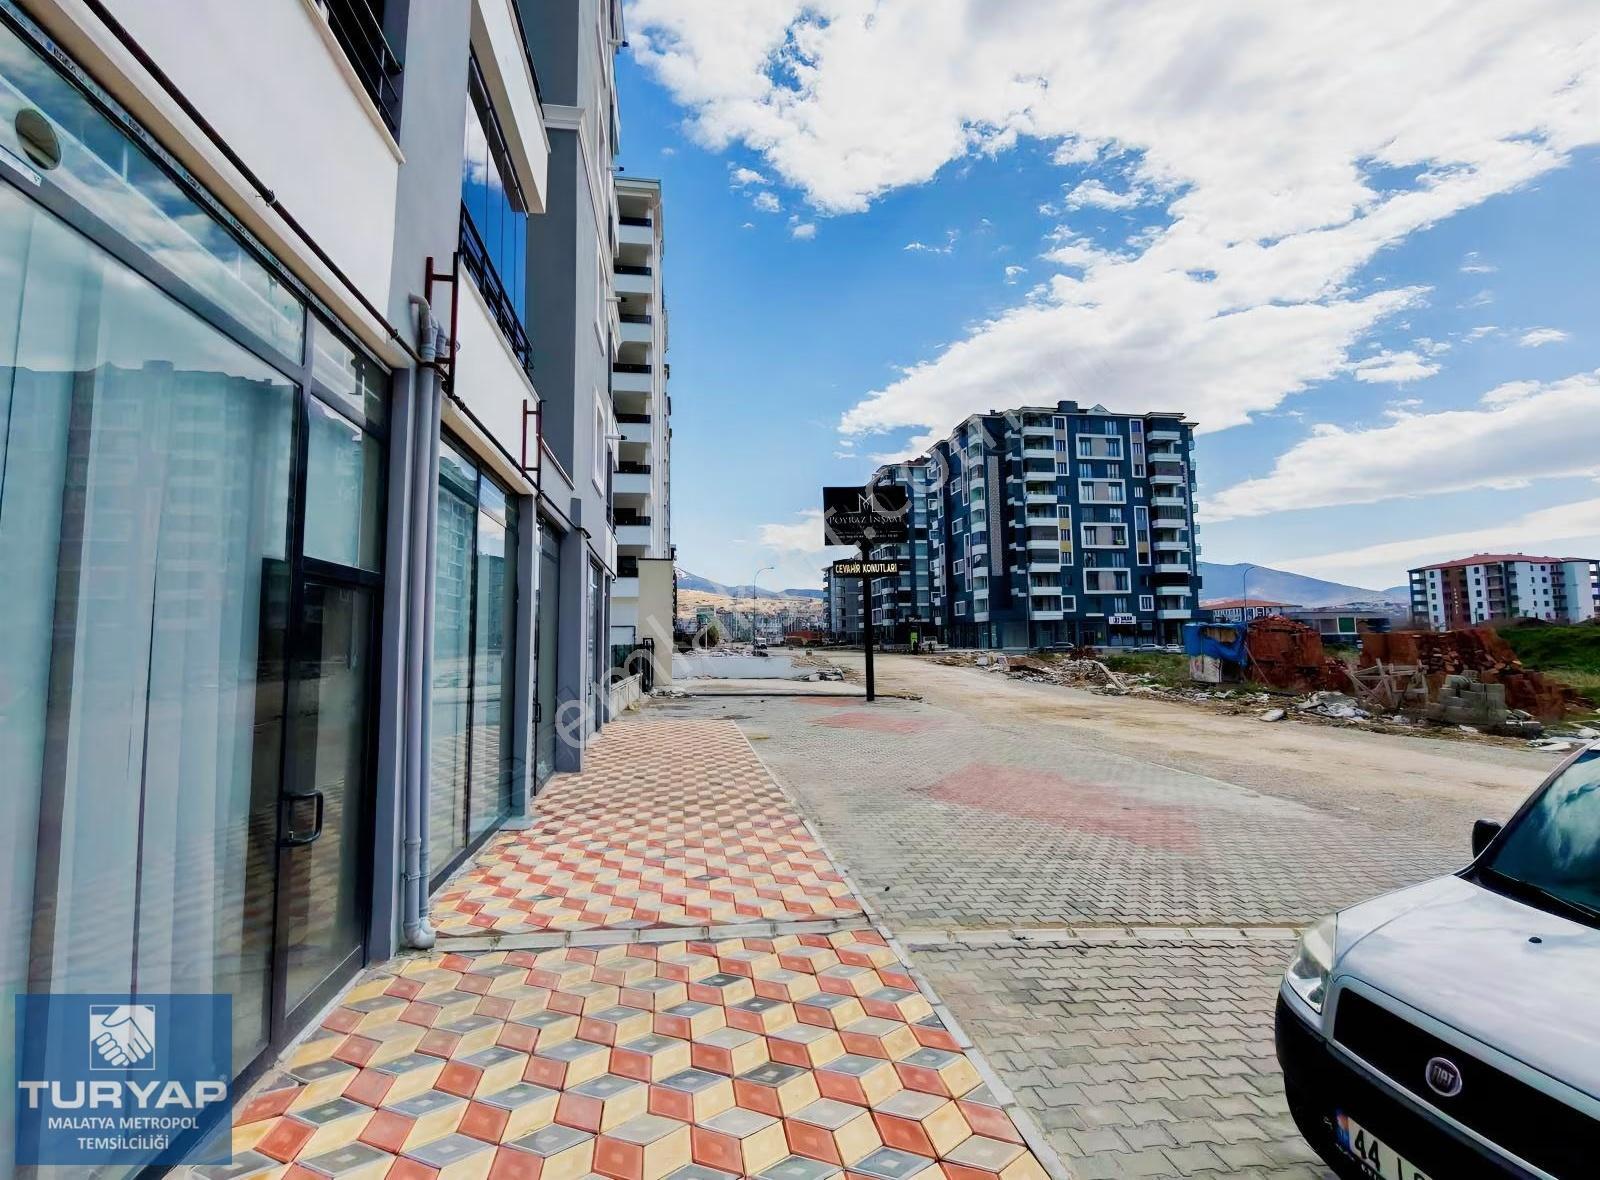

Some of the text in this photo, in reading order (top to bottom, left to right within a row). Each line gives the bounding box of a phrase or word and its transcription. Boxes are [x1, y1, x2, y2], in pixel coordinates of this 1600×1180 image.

[835, 562, 898, 573] CEVAHİR KONUTLARI
[1354, 1129, 1381, 1172] 44
